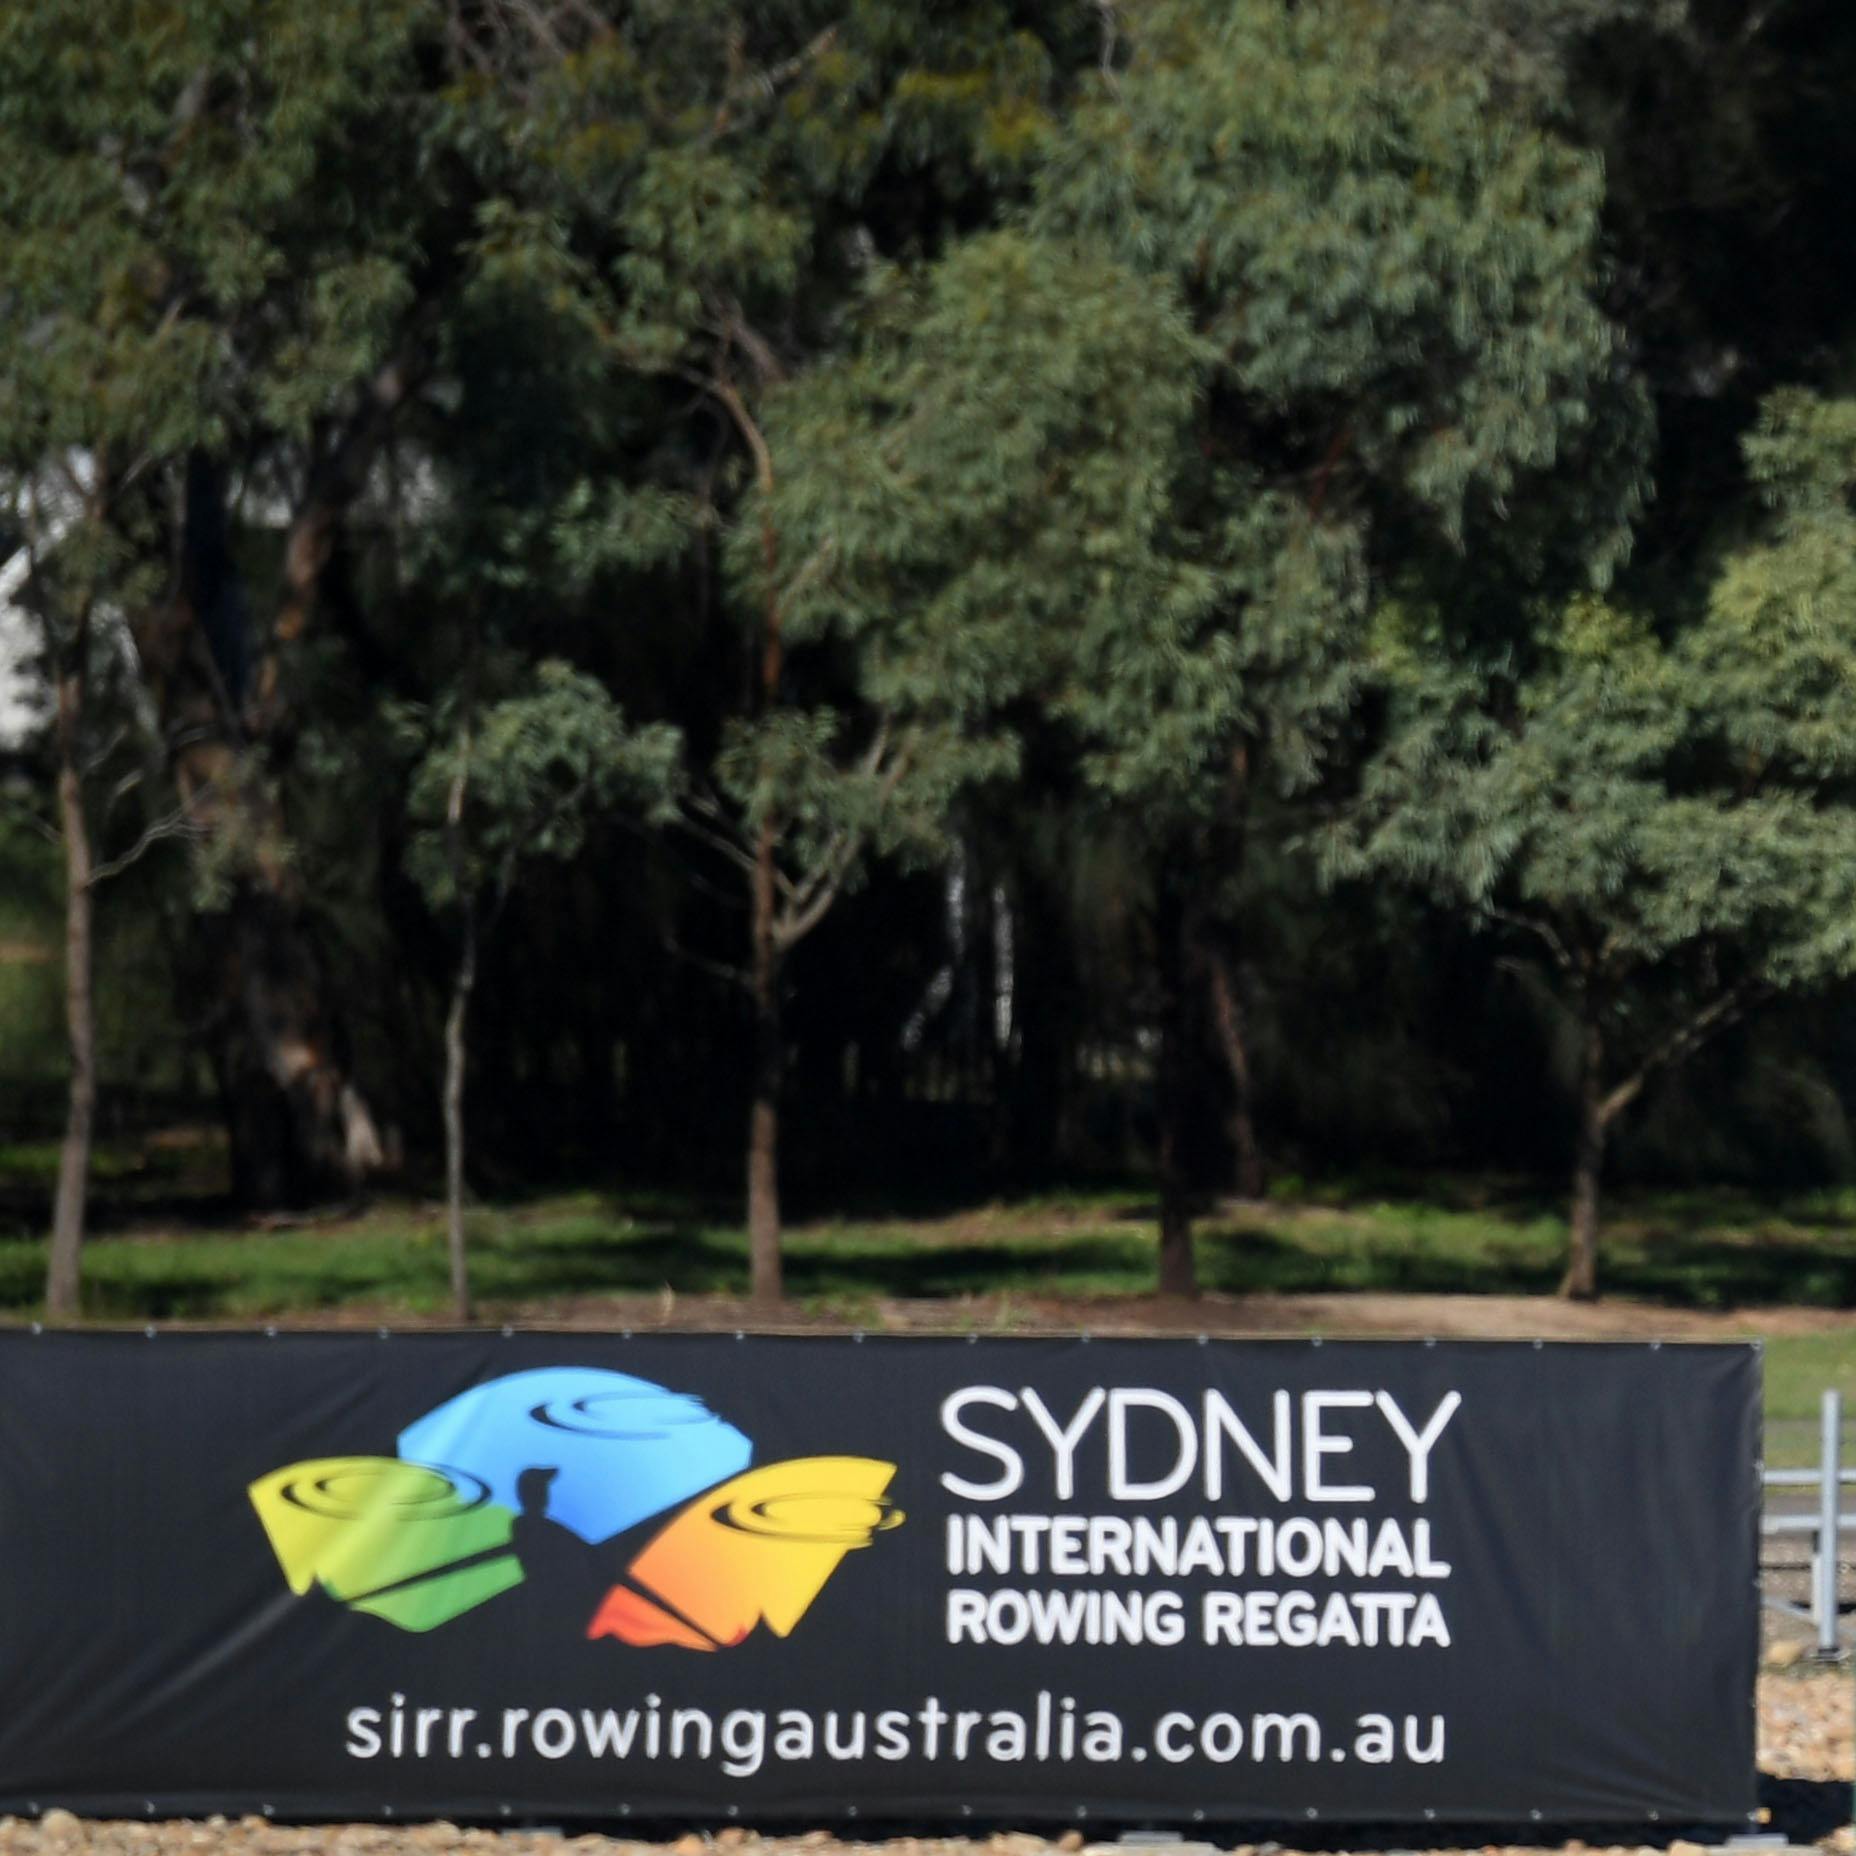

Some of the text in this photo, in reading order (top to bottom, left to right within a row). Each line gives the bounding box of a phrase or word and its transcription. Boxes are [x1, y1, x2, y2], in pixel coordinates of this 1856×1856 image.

[941, 1385, 1462, 1504] SYDNEY
[947, 1514, 1452, 1578] INTERNATIONAL
[946, 1588, 1451, 1649] ROWING REGATTA
[347, 1690, 1446, 1777] sirr.rowingaustralia.com.au
